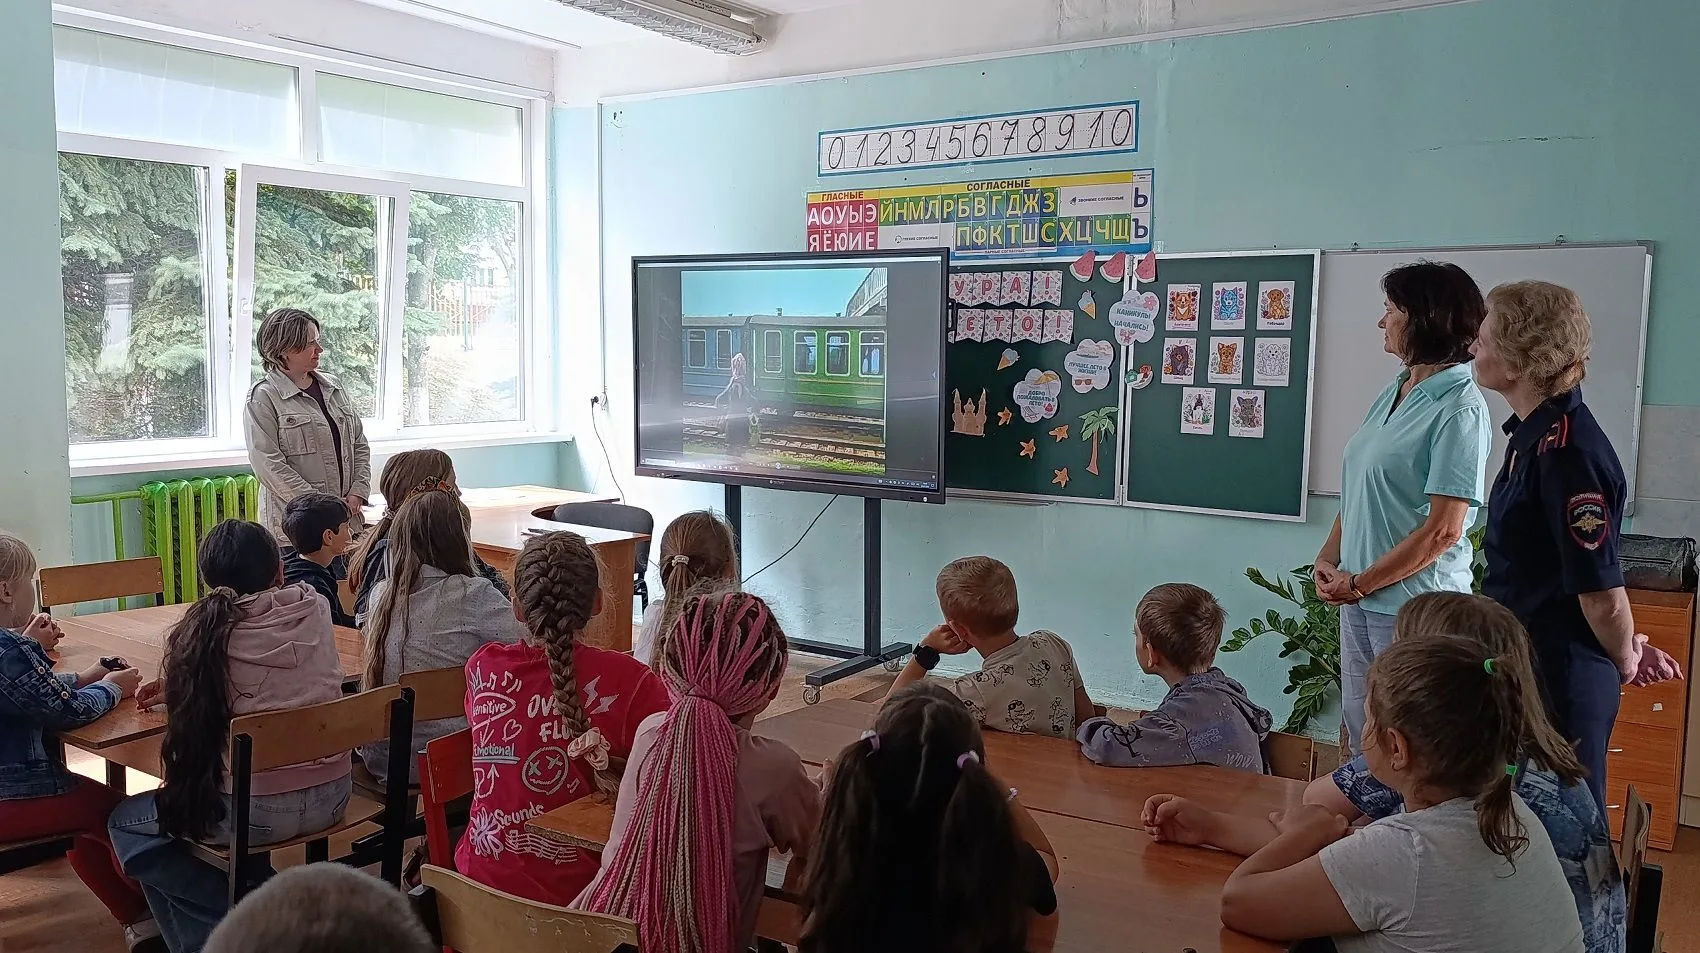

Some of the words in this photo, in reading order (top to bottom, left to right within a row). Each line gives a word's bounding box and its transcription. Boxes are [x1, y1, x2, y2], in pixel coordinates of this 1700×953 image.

[967, 179, 1030, 192] СОГЛАСНЫЕ
[822, 191, 864, 201] ГЛАСНЫЕ
[1116, 308, 1151, 319] КАНИКУЛЫ
[966, 316, 1061, 333] ЕТО!
[1114, 320, 1149, 331] НАЧАЛИСЬ!
[1574, 504, 1602, 516] РОССИЯ
